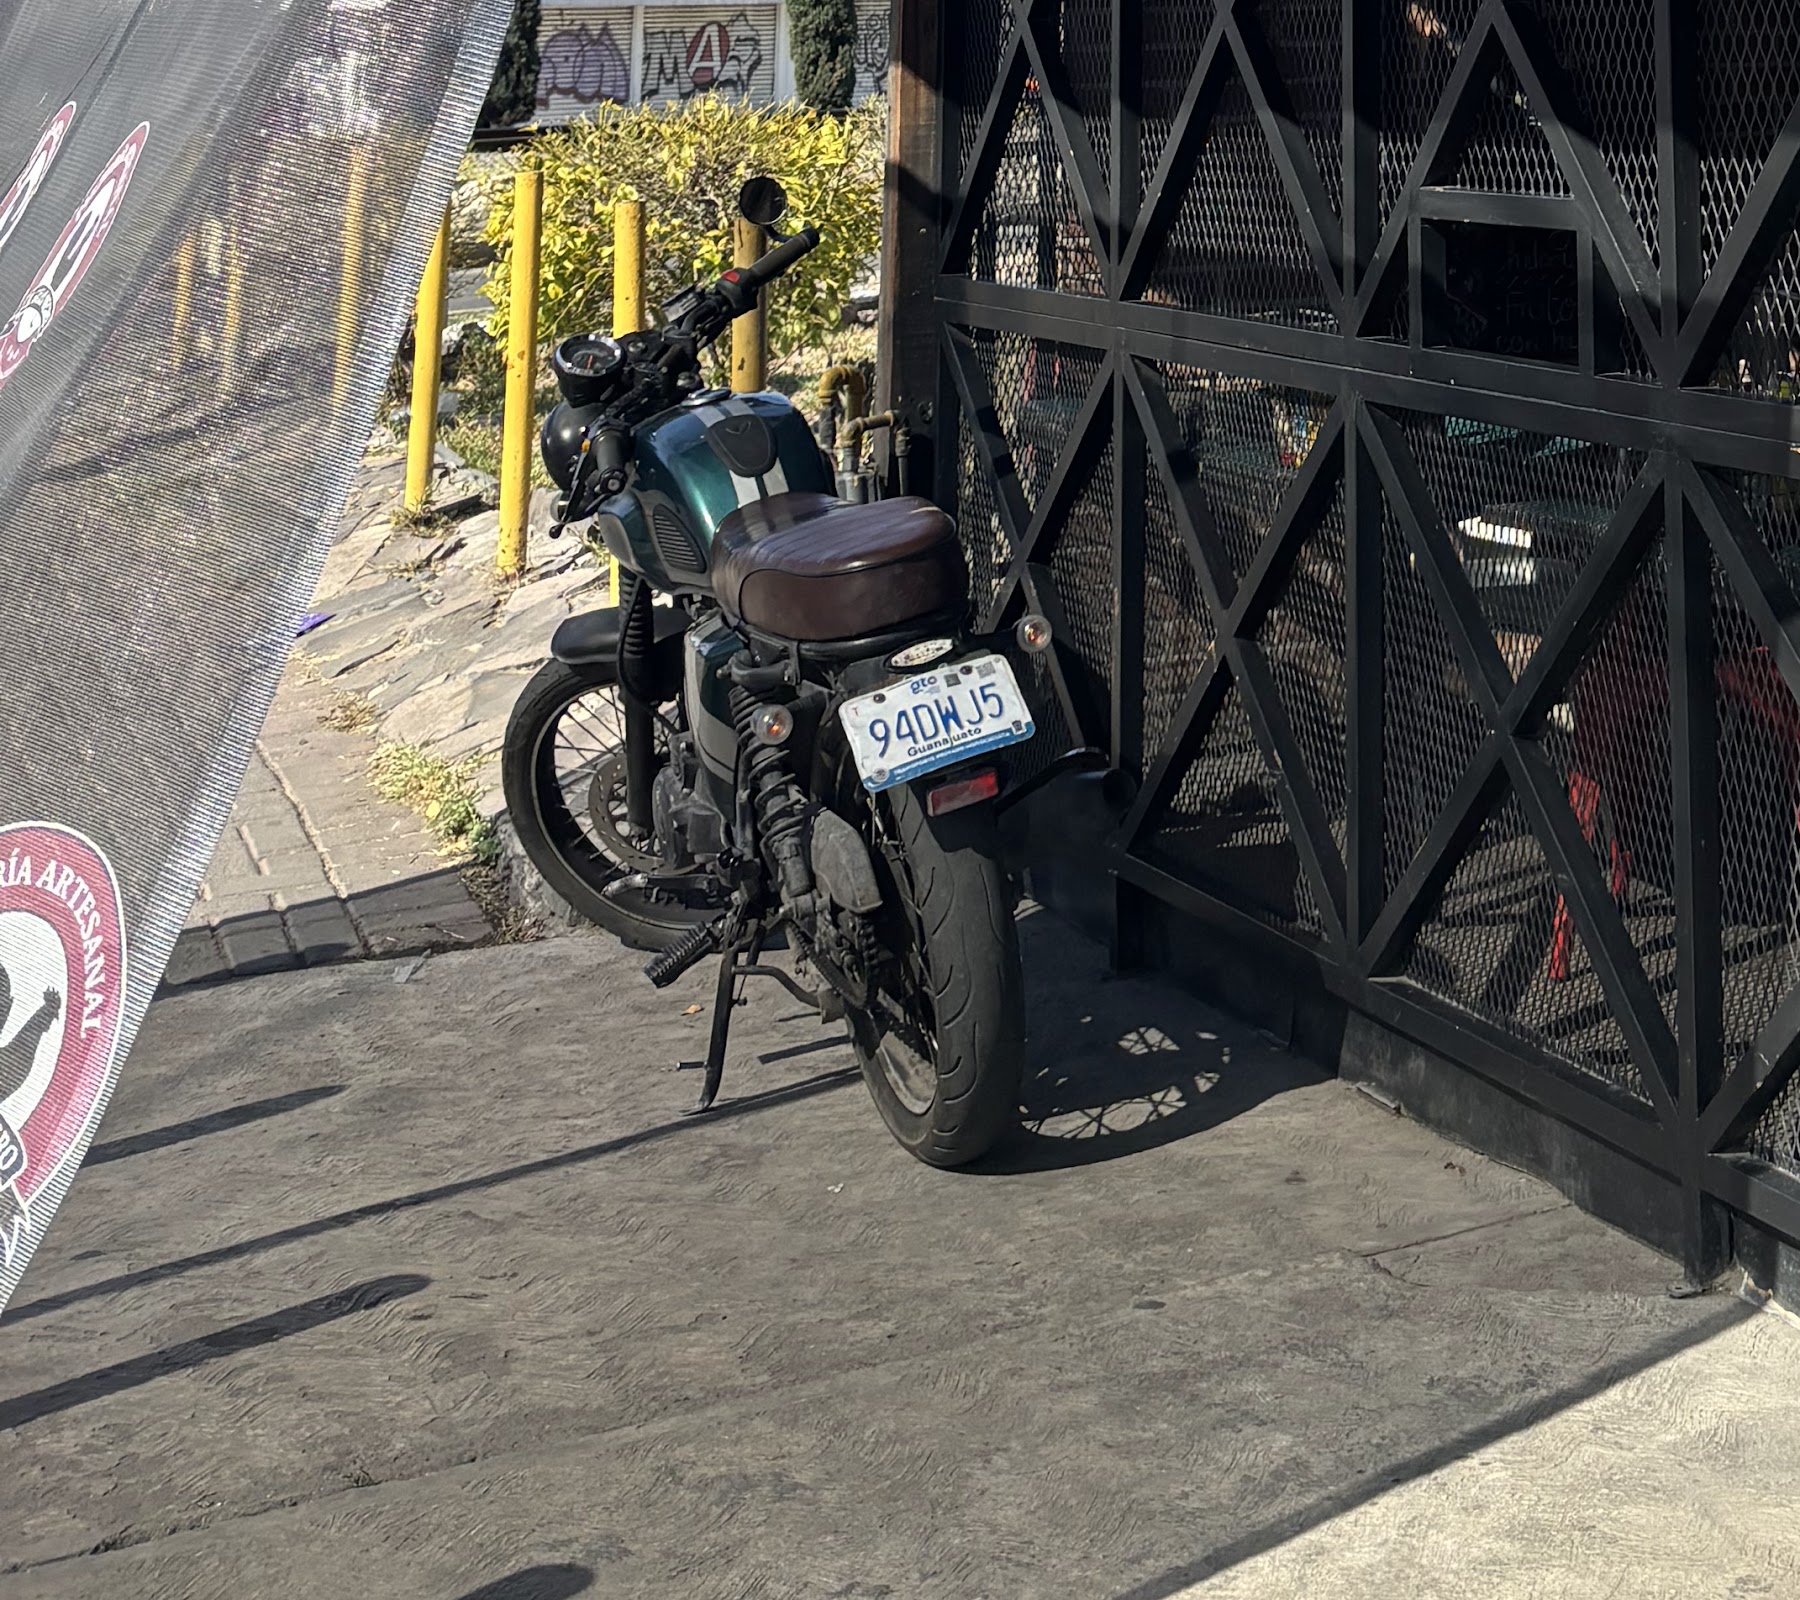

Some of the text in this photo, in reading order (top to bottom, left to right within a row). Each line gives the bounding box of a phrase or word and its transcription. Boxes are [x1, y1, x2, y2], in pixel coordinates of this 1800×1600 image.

[910, 676, 938, 694] gto
[869, 682, 1004, 758] 94DWJ5
[907, 727, 982, 757] Guanajuato
[36, 860, 106, 1039] ARTESANAL
